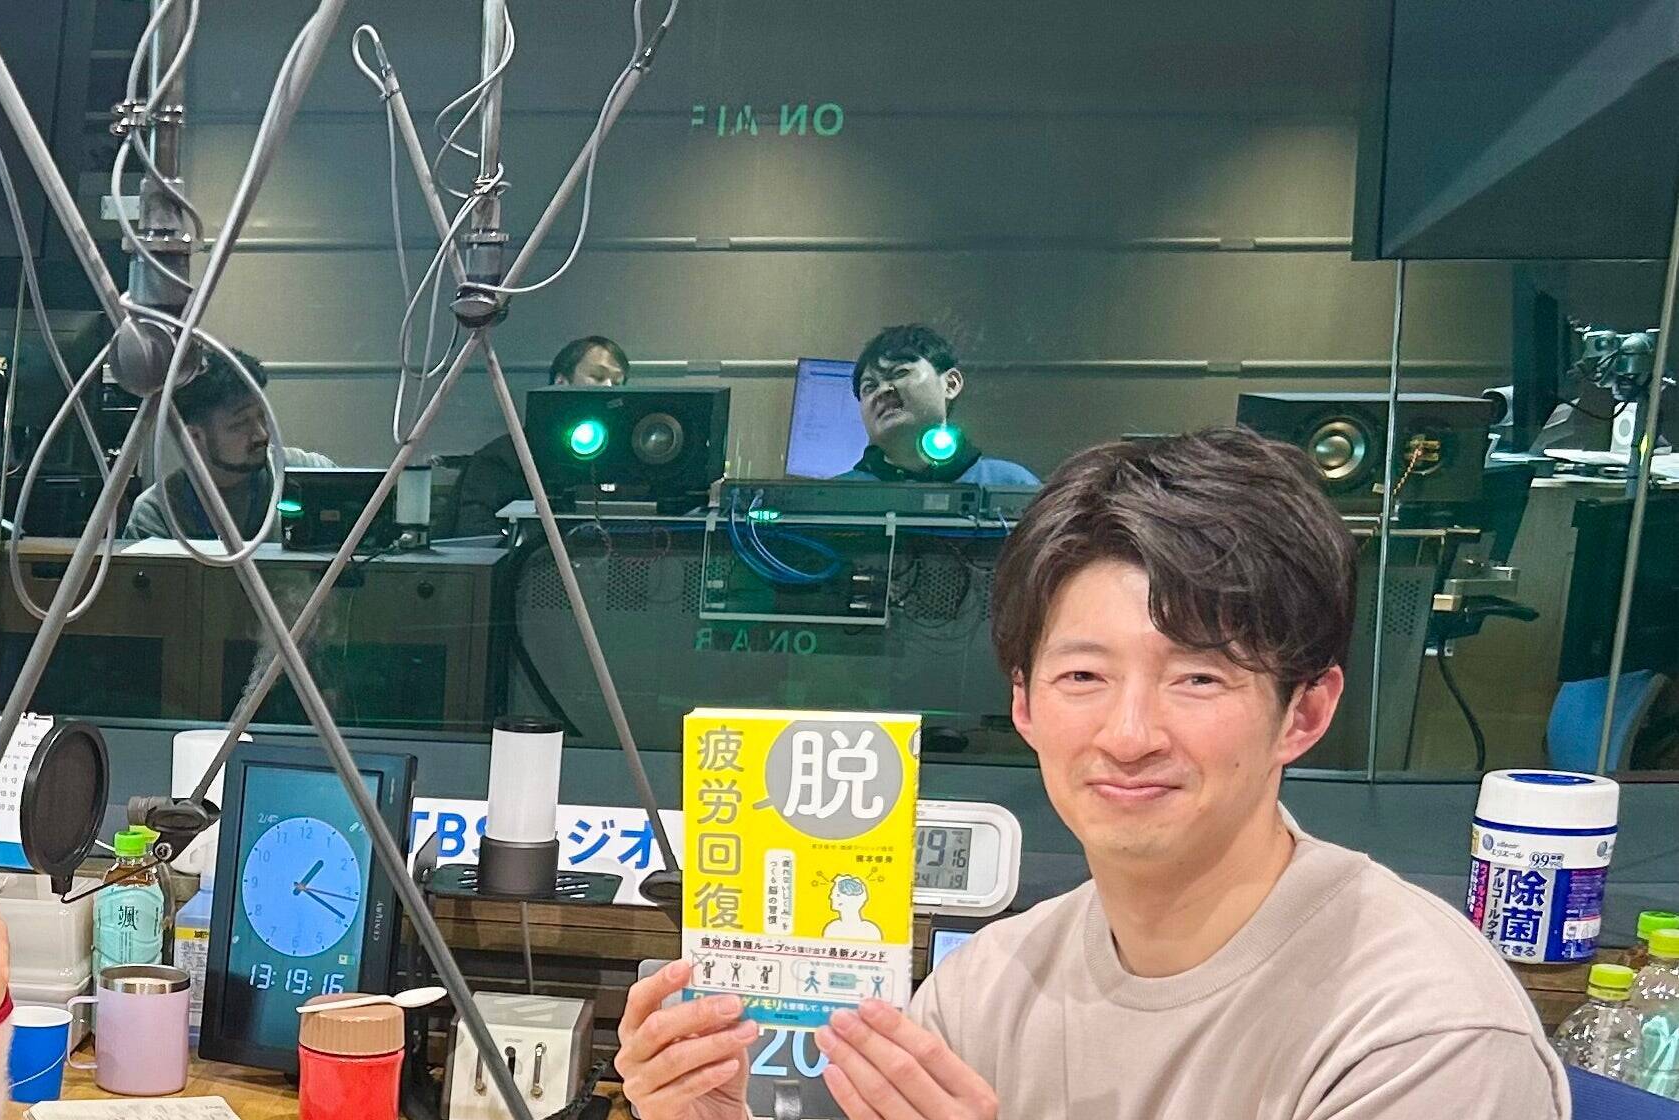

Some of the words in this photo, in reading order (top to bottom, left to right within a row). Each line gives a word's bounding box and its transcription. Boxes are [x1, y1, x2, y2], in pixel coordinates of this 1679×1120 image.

[10, 776, 18, 784] 12
[783, 730, 885, 820] 脱
[299, 825, 313, 840] 12
[693, 724, 745, 931] 疲労回復
[275, 830, 289, 845] 11
[256, 849, 271, 862] 10
[340, 858, 348, 871] 2
[251, 875, 259, 889] 9
[254, 903, 263, 917] 8
[1484, 866, 1506, 940] アルコールタオ
[1503, 869, 1548, 945] 除菌
[372, 900, 385, 942] CENTURY
[270, 925, 278, 937] 7
[315, 931, 324, 945] 5
[291, 935, 300, 949] 6
[1500, 943, 1537, 957] できる
[249, 962, 346, 996] 13:19:16
